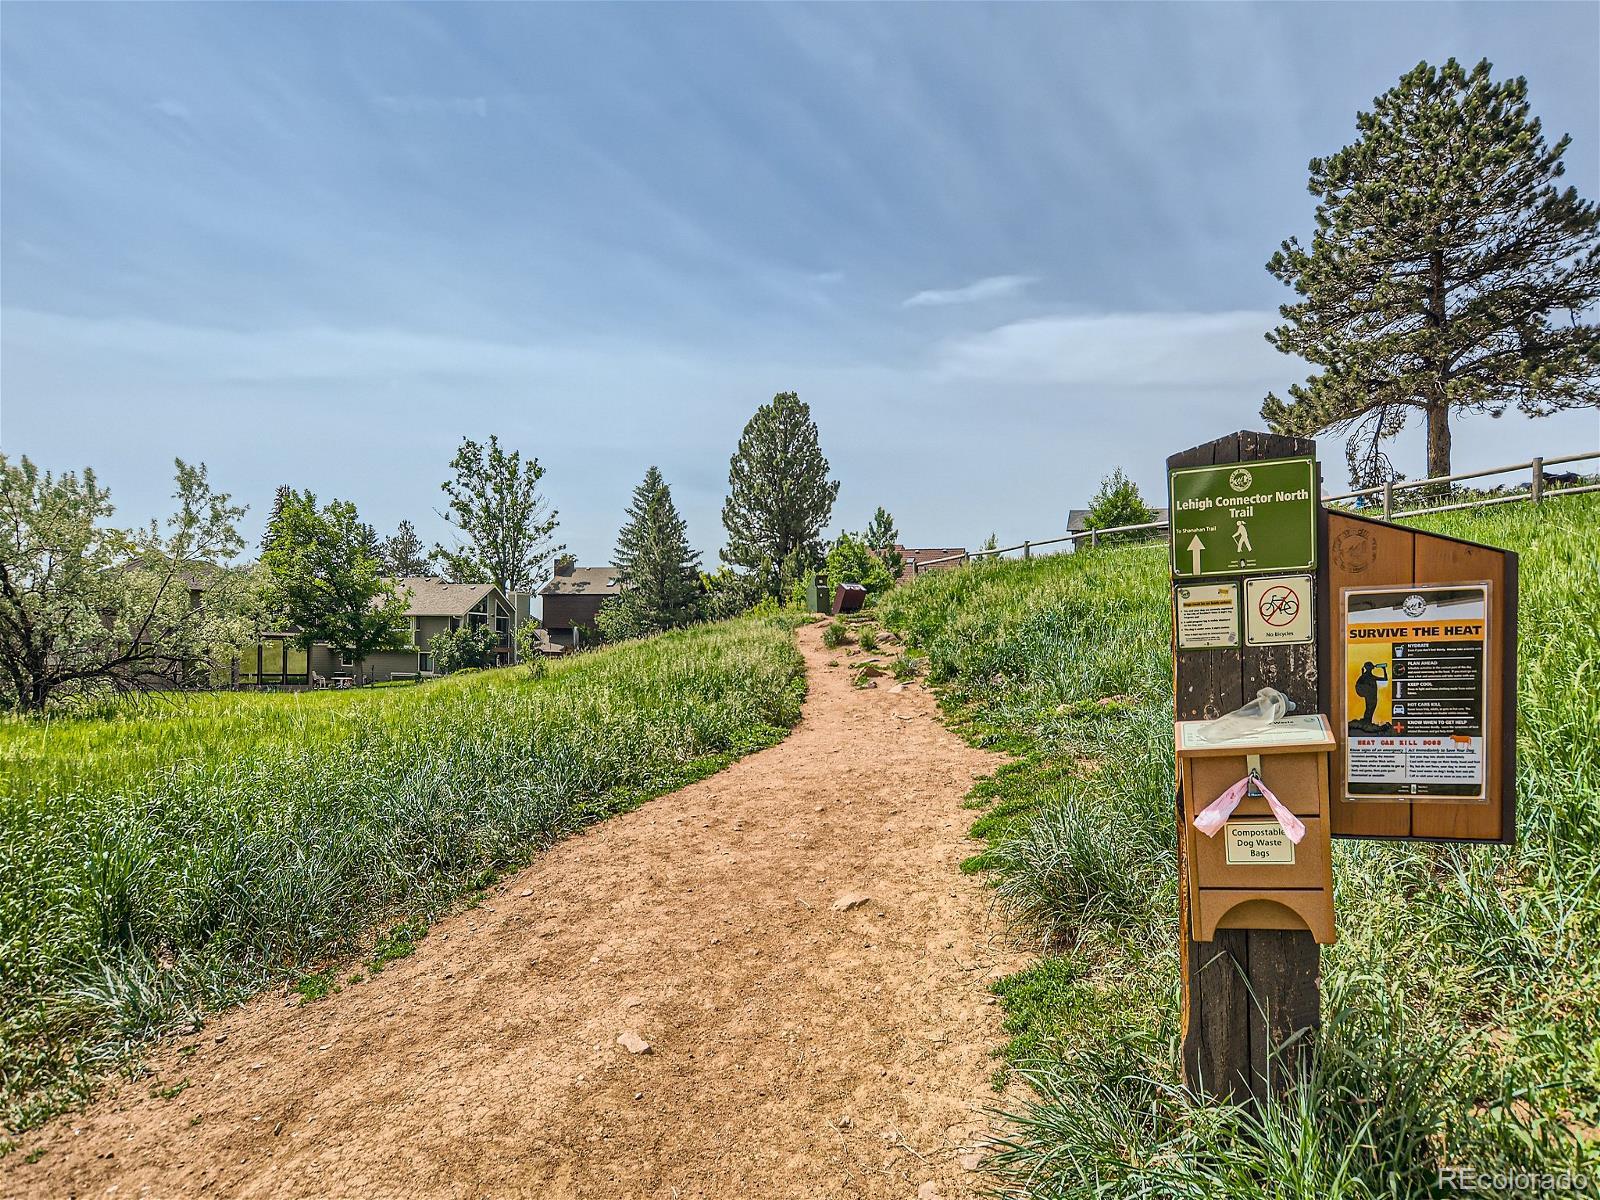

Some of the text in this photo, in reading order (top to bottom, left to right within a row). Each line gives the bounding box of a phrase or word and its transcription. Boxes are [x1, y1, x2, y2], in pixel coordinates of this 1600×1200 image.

[1176, 489, 1309, 511] Lehigh Connector North
[1228, 506, 1254, 518] Trail
[1349, 625, 1482, 639] SURVIVE THE HEAT
[1232, 828, 1286, 837] Compostable
[1250, 850, 1270, 858] Bags
